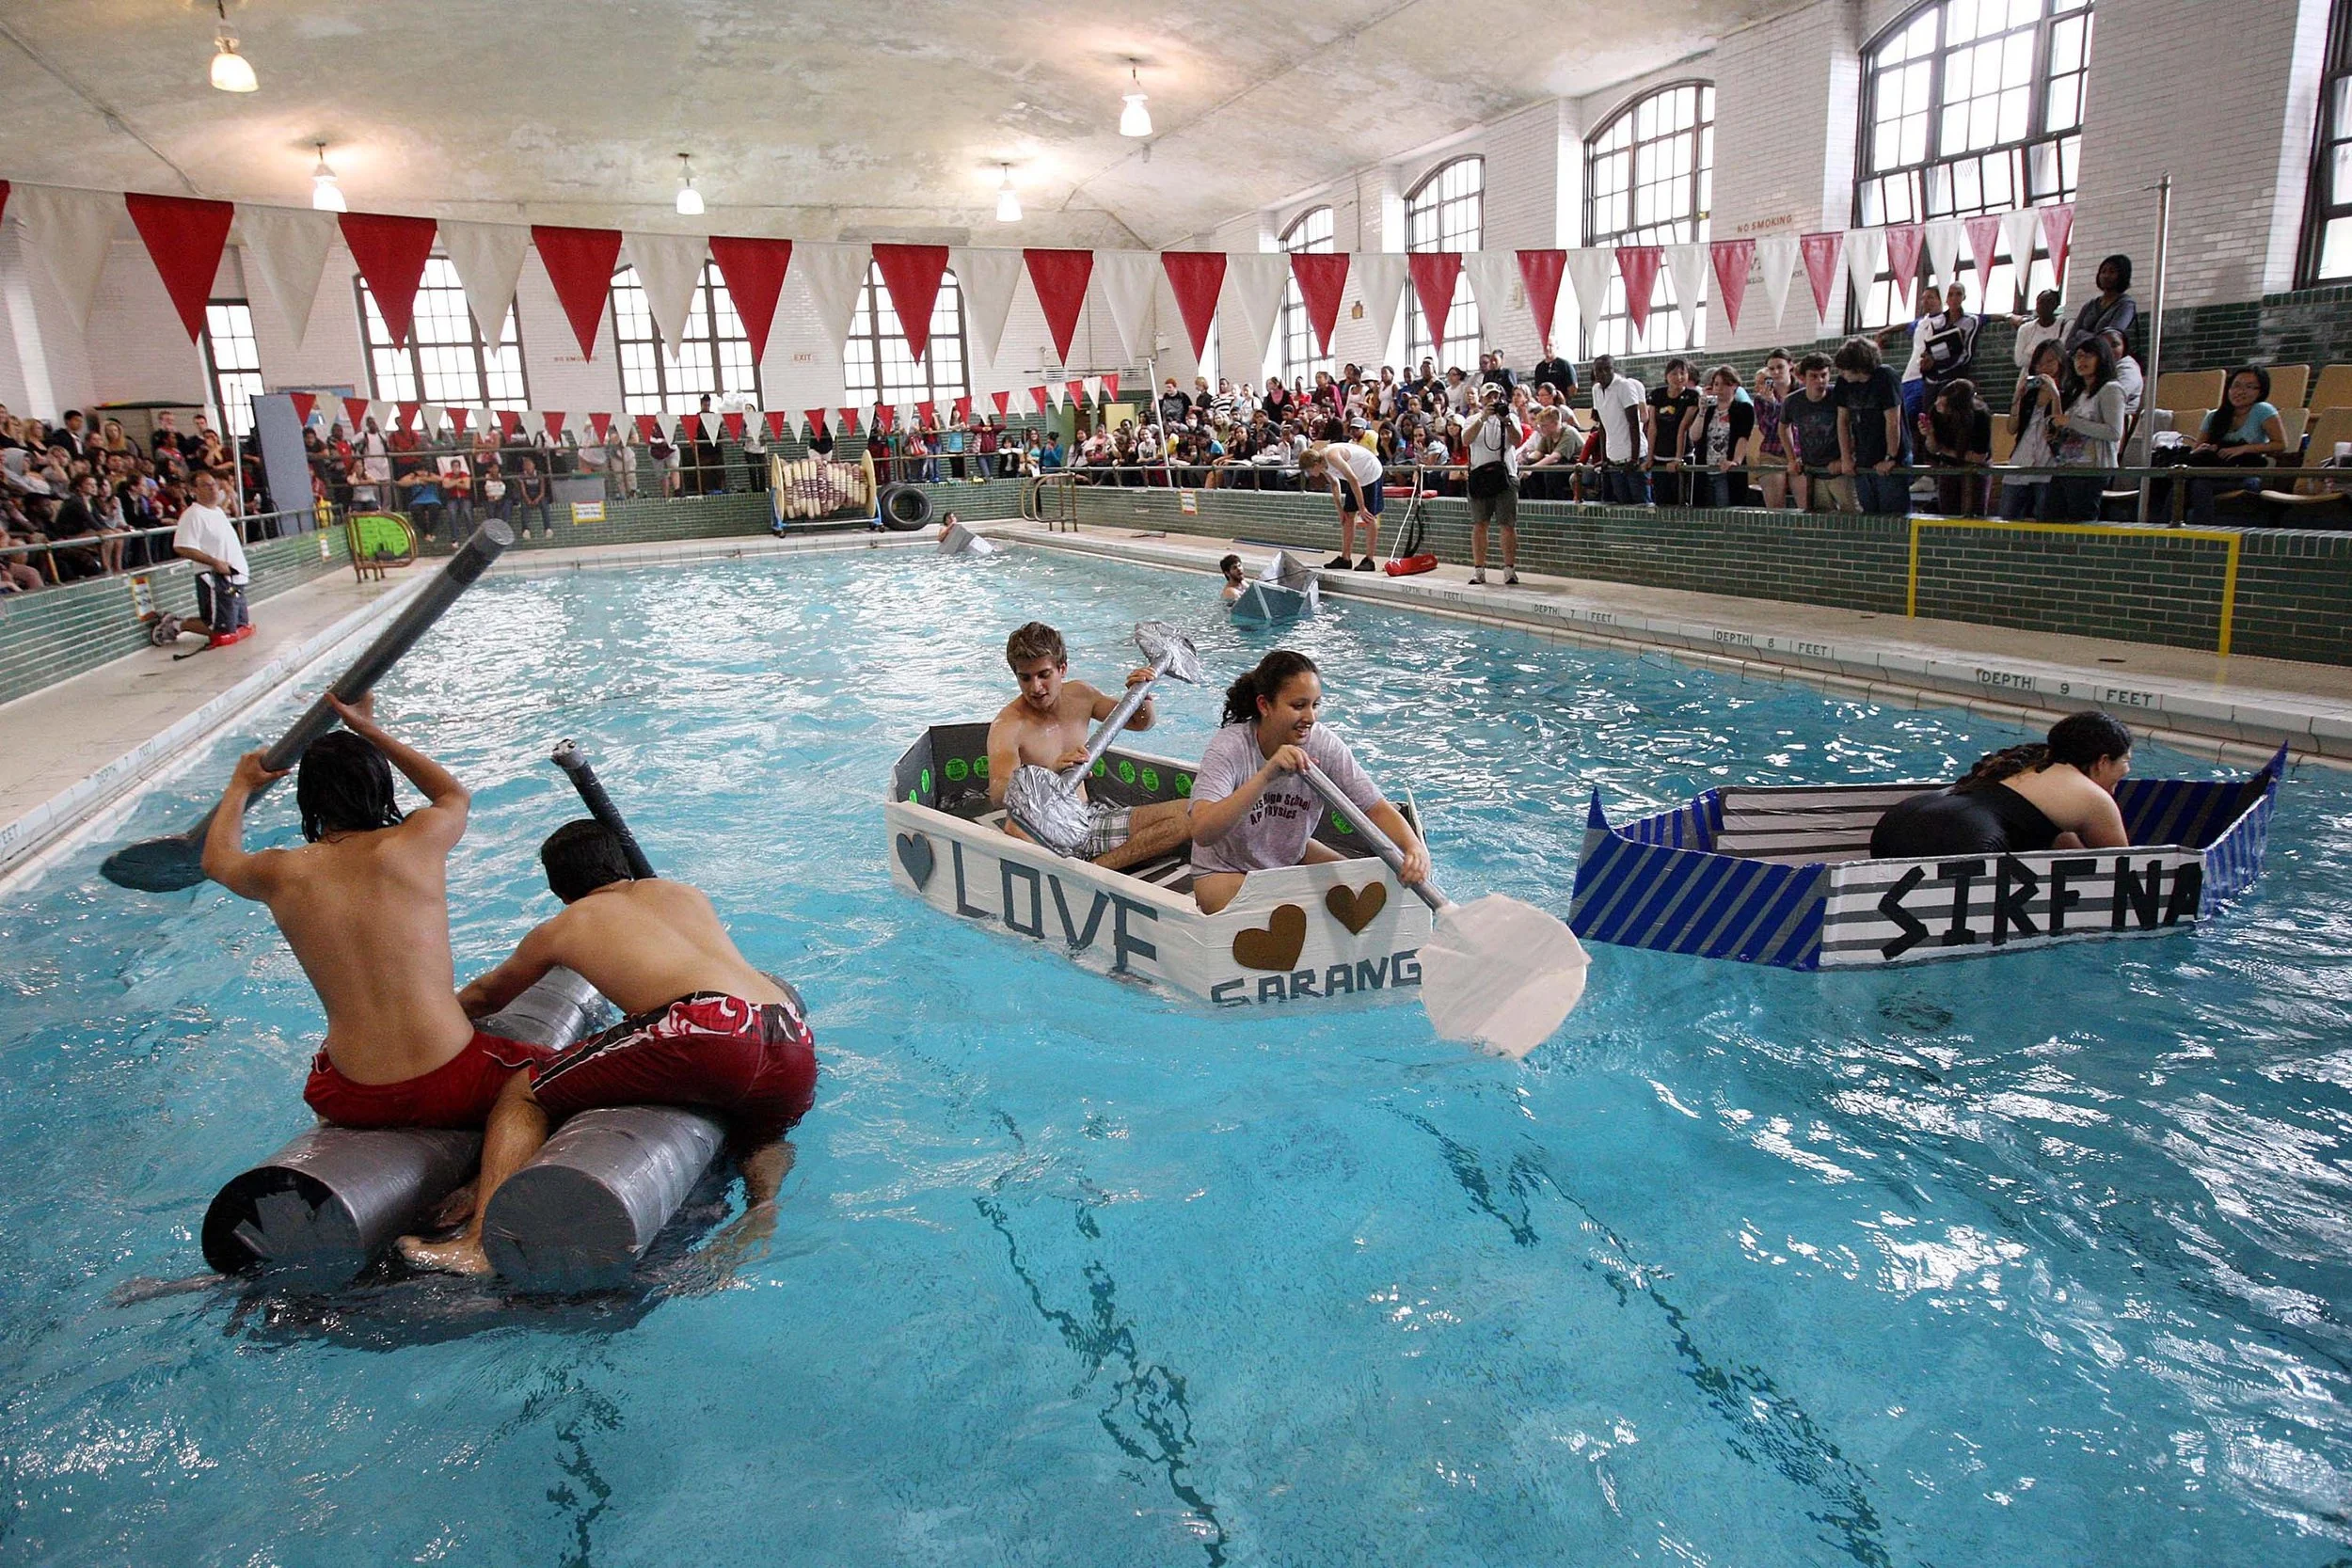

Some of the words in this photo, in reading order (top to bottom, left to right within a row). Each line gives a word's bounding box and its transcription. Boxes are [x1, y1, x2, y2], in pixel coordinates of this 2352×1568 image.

[1737, 223, 1749, 233] NO
[1751, 214, 1792, 230] SMOKING
[1534, 604, 1558, 615] DEPTH
[1570, 610, 1575, 618] 7
[1591, 612, 1612, 623] FEET
[1716, 631, 1750, 644] DEPTH
[1768, 638, 1774, 648] 8
[1798, 642, 1827, 657] FEET
[1981, 671, 2031, 689] DEPTH
[2060, 683, 2069, 695] 9
[2106, 689, 2152, 706] FEET
[1263, 792, 1282, 804] High
[1249, 811, 1263, 825] AP
[1263, 805, 1297, 819] Physics
[952, 840, 1158, 986] LOVE
[1210, 948, 1422, 1008] SARANG
